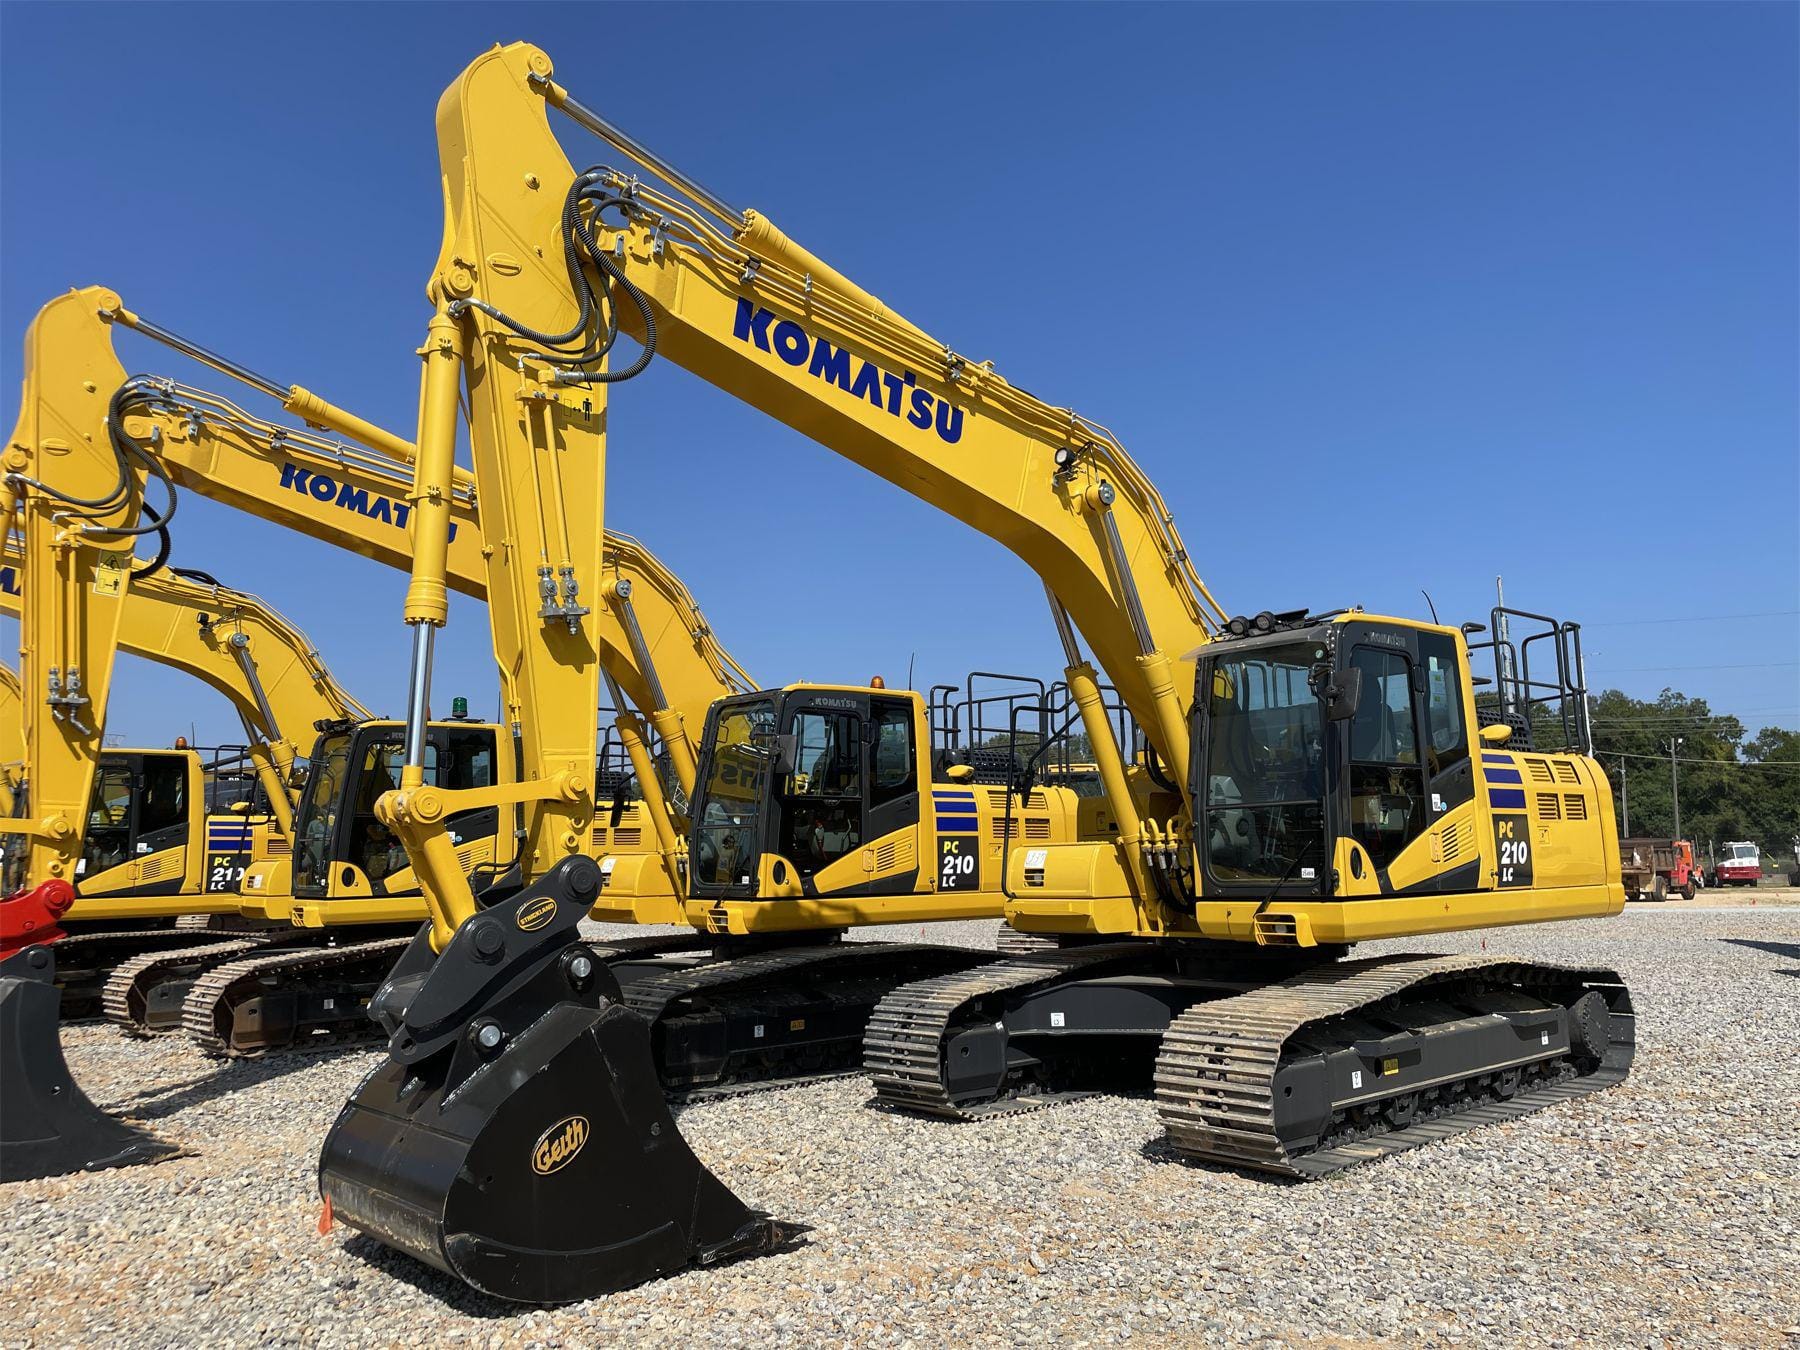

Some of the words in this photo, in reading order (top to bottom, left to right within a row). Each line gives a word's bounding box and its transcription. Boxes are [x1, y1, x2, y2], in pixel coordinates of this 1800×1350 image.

[733, 296, 964, 443] KOMATSU
[280, 462, 457, 544] KOMAT
[815, 697, 857, 709] KOMATSU
[1498, 821, 1513, 838] PC
[943, 841, 959, 853] PC
[1501, 841, 1528, 864] 210
[213, 857, 231, 866] PC
[942, 855, 974, 874] 210
[1502, 867, 1514, 881] LC
[210, 882, 225, 890] LC
[942, 876, 956, 887] LC
